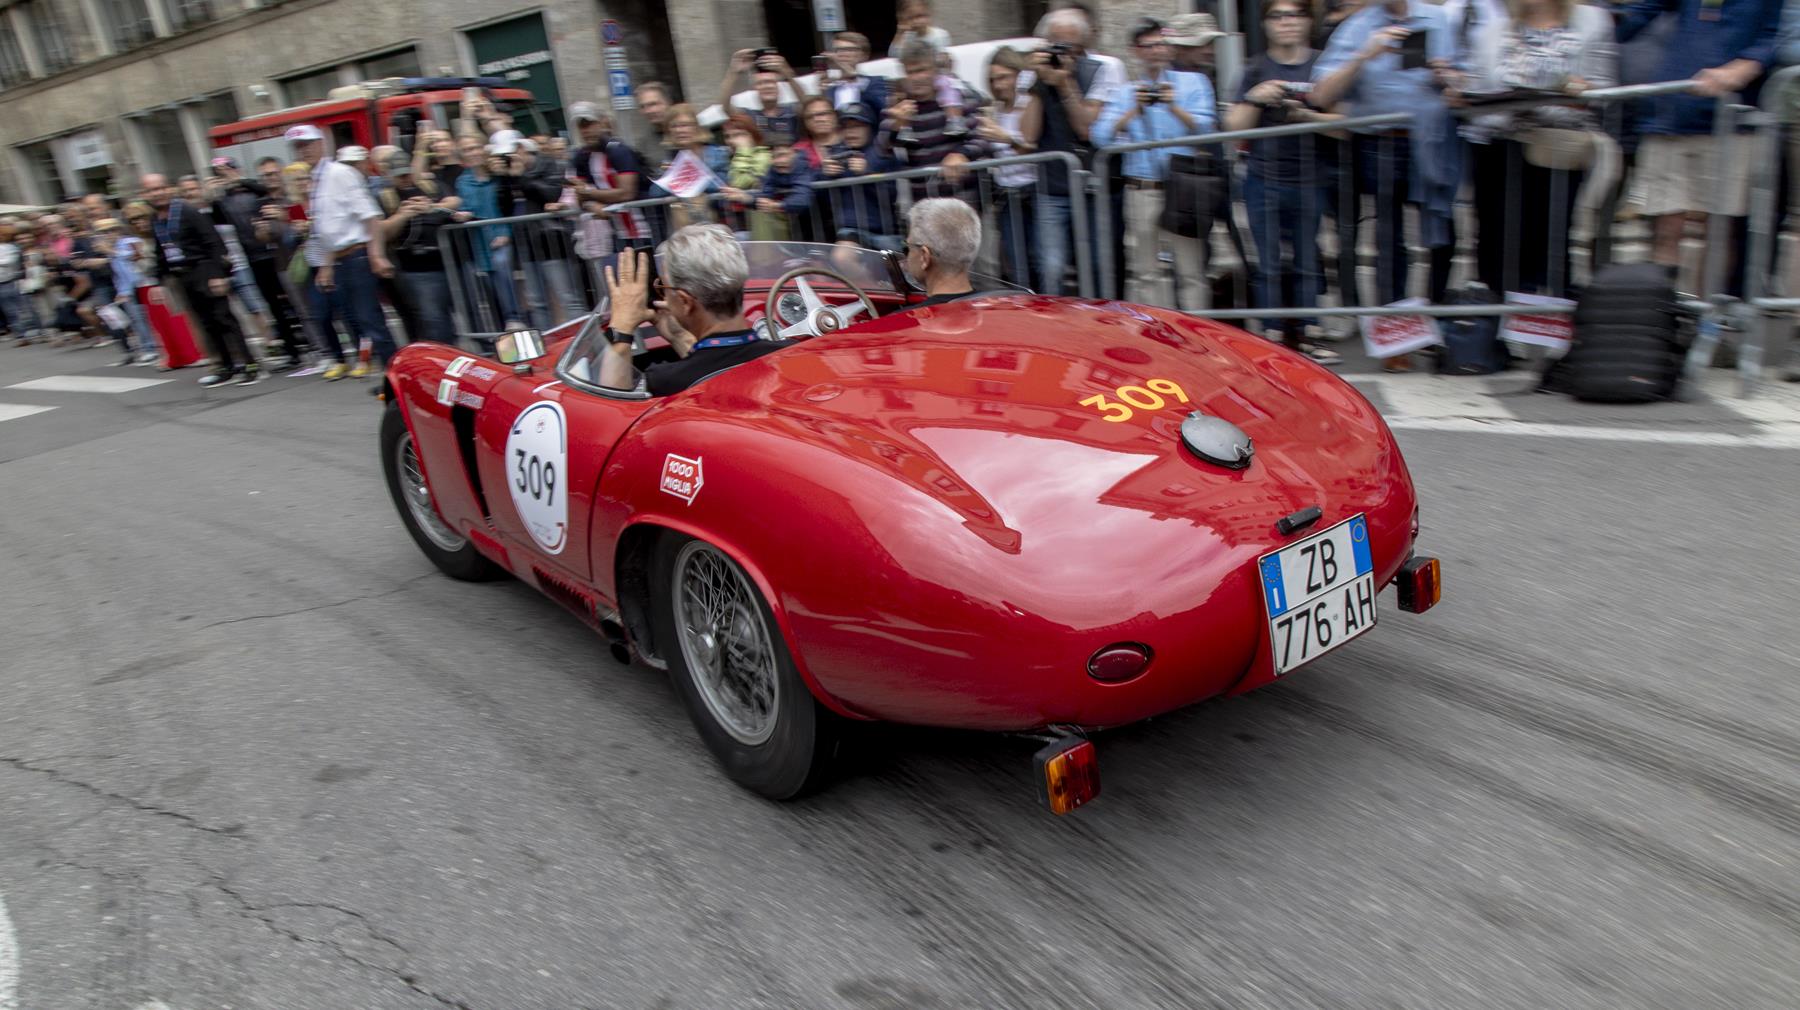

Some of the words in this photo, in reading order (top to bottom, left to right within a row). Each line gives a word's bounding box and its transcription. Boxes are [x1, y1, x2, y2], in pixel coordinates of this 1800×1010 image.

[1079, 379, 1189, 422] 309
[515, 448, 555, 506] 309
[664, 476, 691, 495] MIGLIA
[668, 460, 693, 478] 1000
[1301, 538, 1338, 595] ZB
[1277, 602, 1331, 668] 776
[1345, 577, 1374, 635] AH
